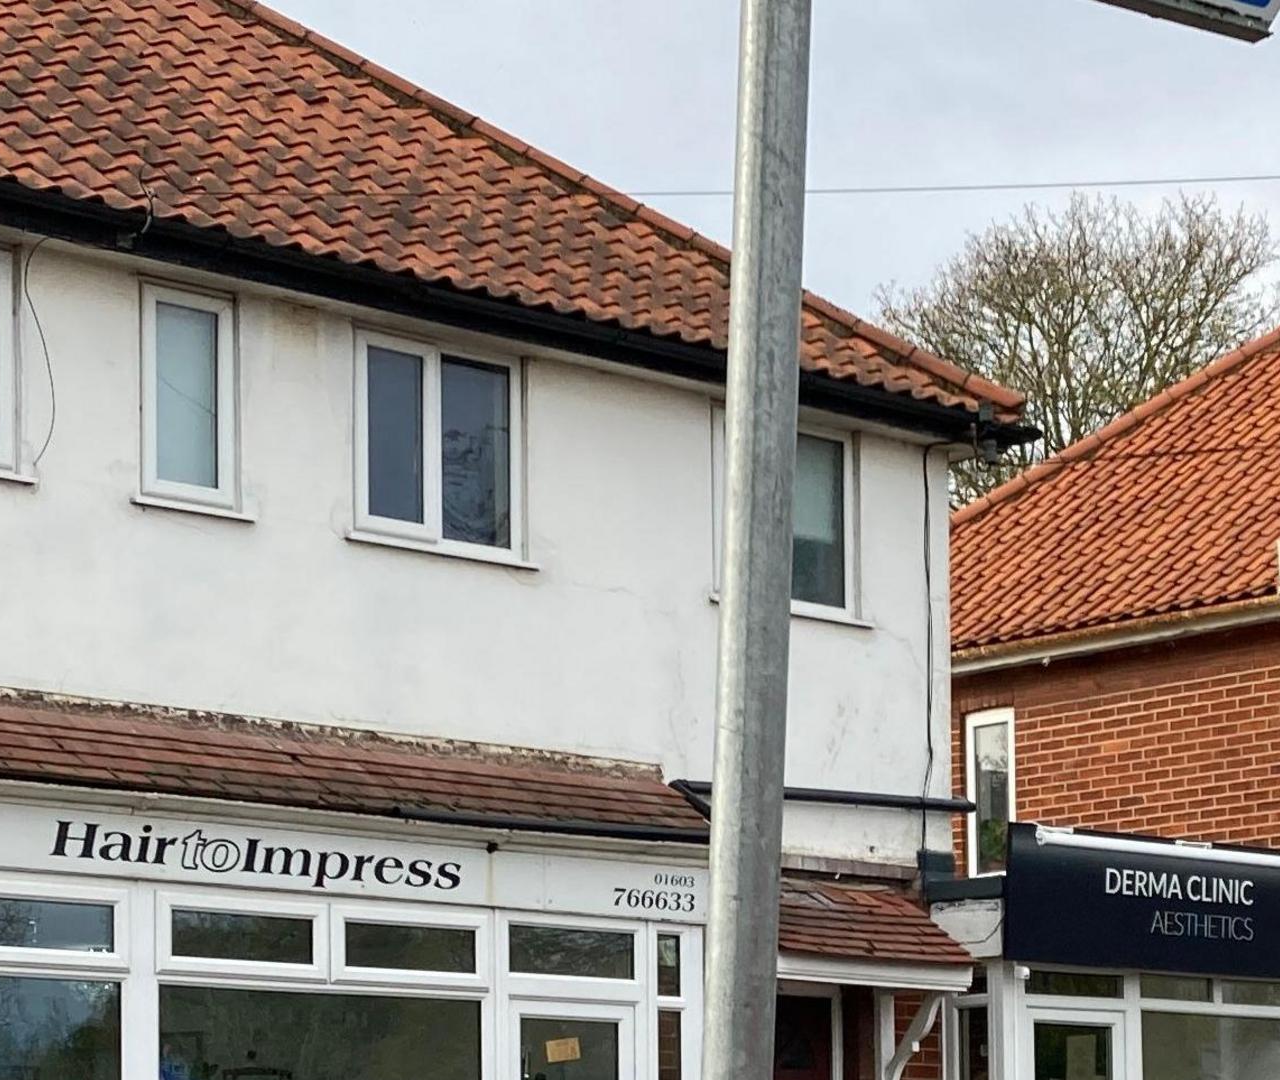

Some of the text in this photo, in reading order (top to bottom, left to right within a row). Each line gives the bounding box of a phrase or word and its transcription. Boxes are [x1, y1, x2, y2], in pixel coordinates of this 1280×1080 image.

[654, 872, 695, 888] 01603
[1105, 867, 1255, 906] DERMA CLINIC
[613, 887, 695, 913] 766633
[1150, 910, 1255, 942] AESTHETICS
